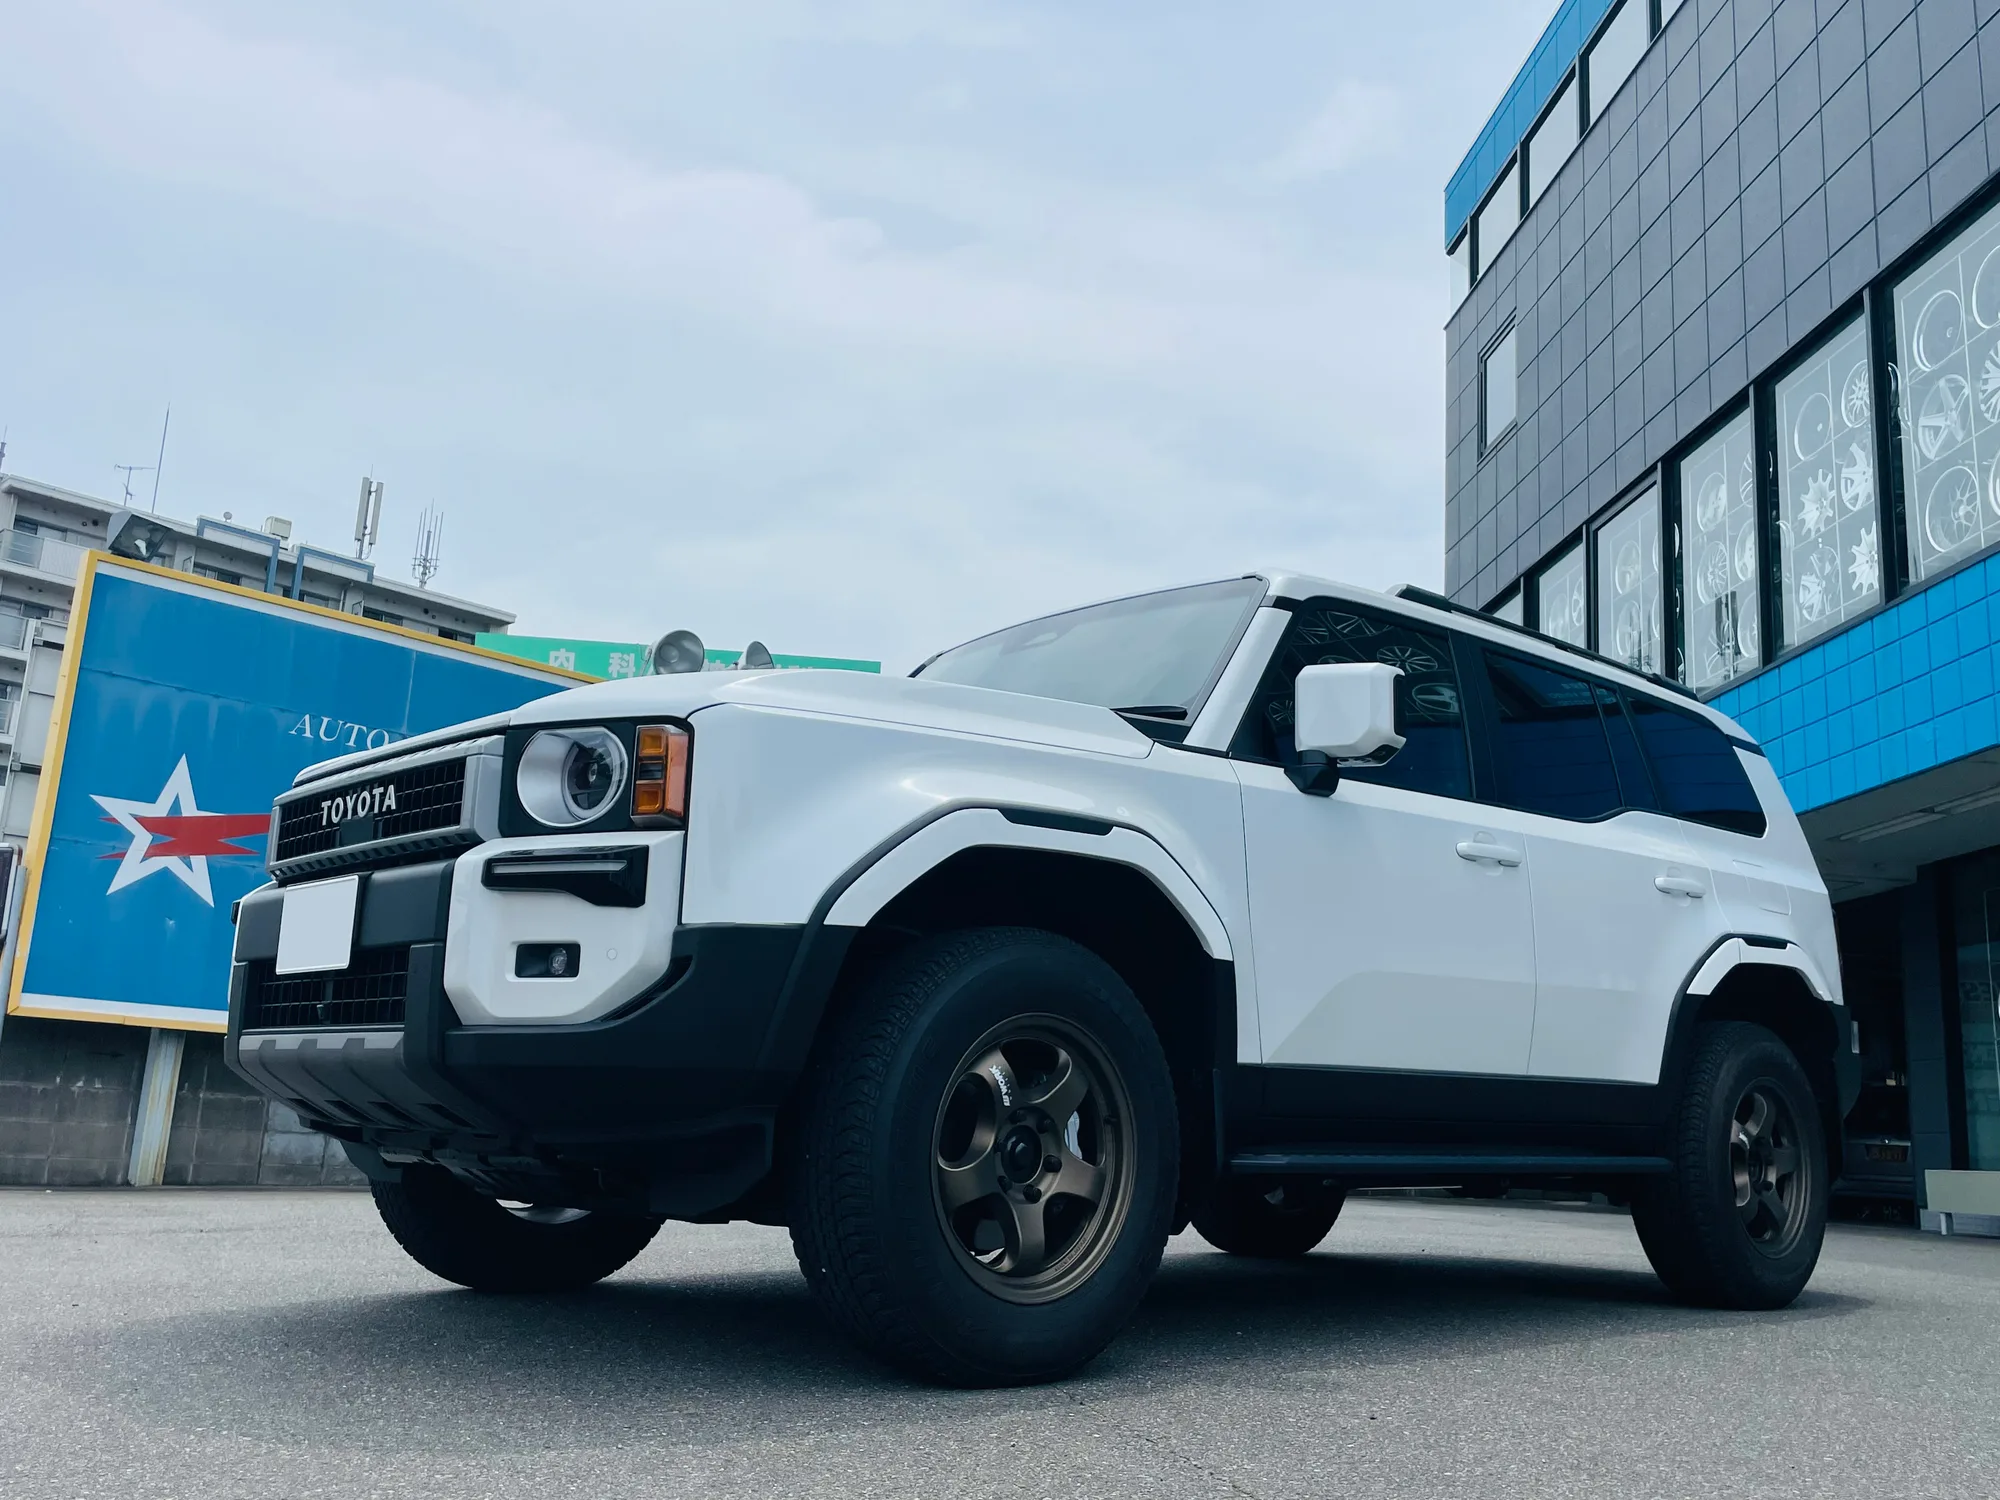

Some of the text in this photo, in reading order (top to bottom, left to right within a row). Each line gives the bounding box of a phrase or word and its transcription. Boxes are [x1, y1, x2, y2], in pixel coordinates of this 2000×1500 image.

[288, 713, 390, 751] AUTO
[321, 784, 396, 826] TOYOTA
[988, 1064, 1009, 1096] WORK
